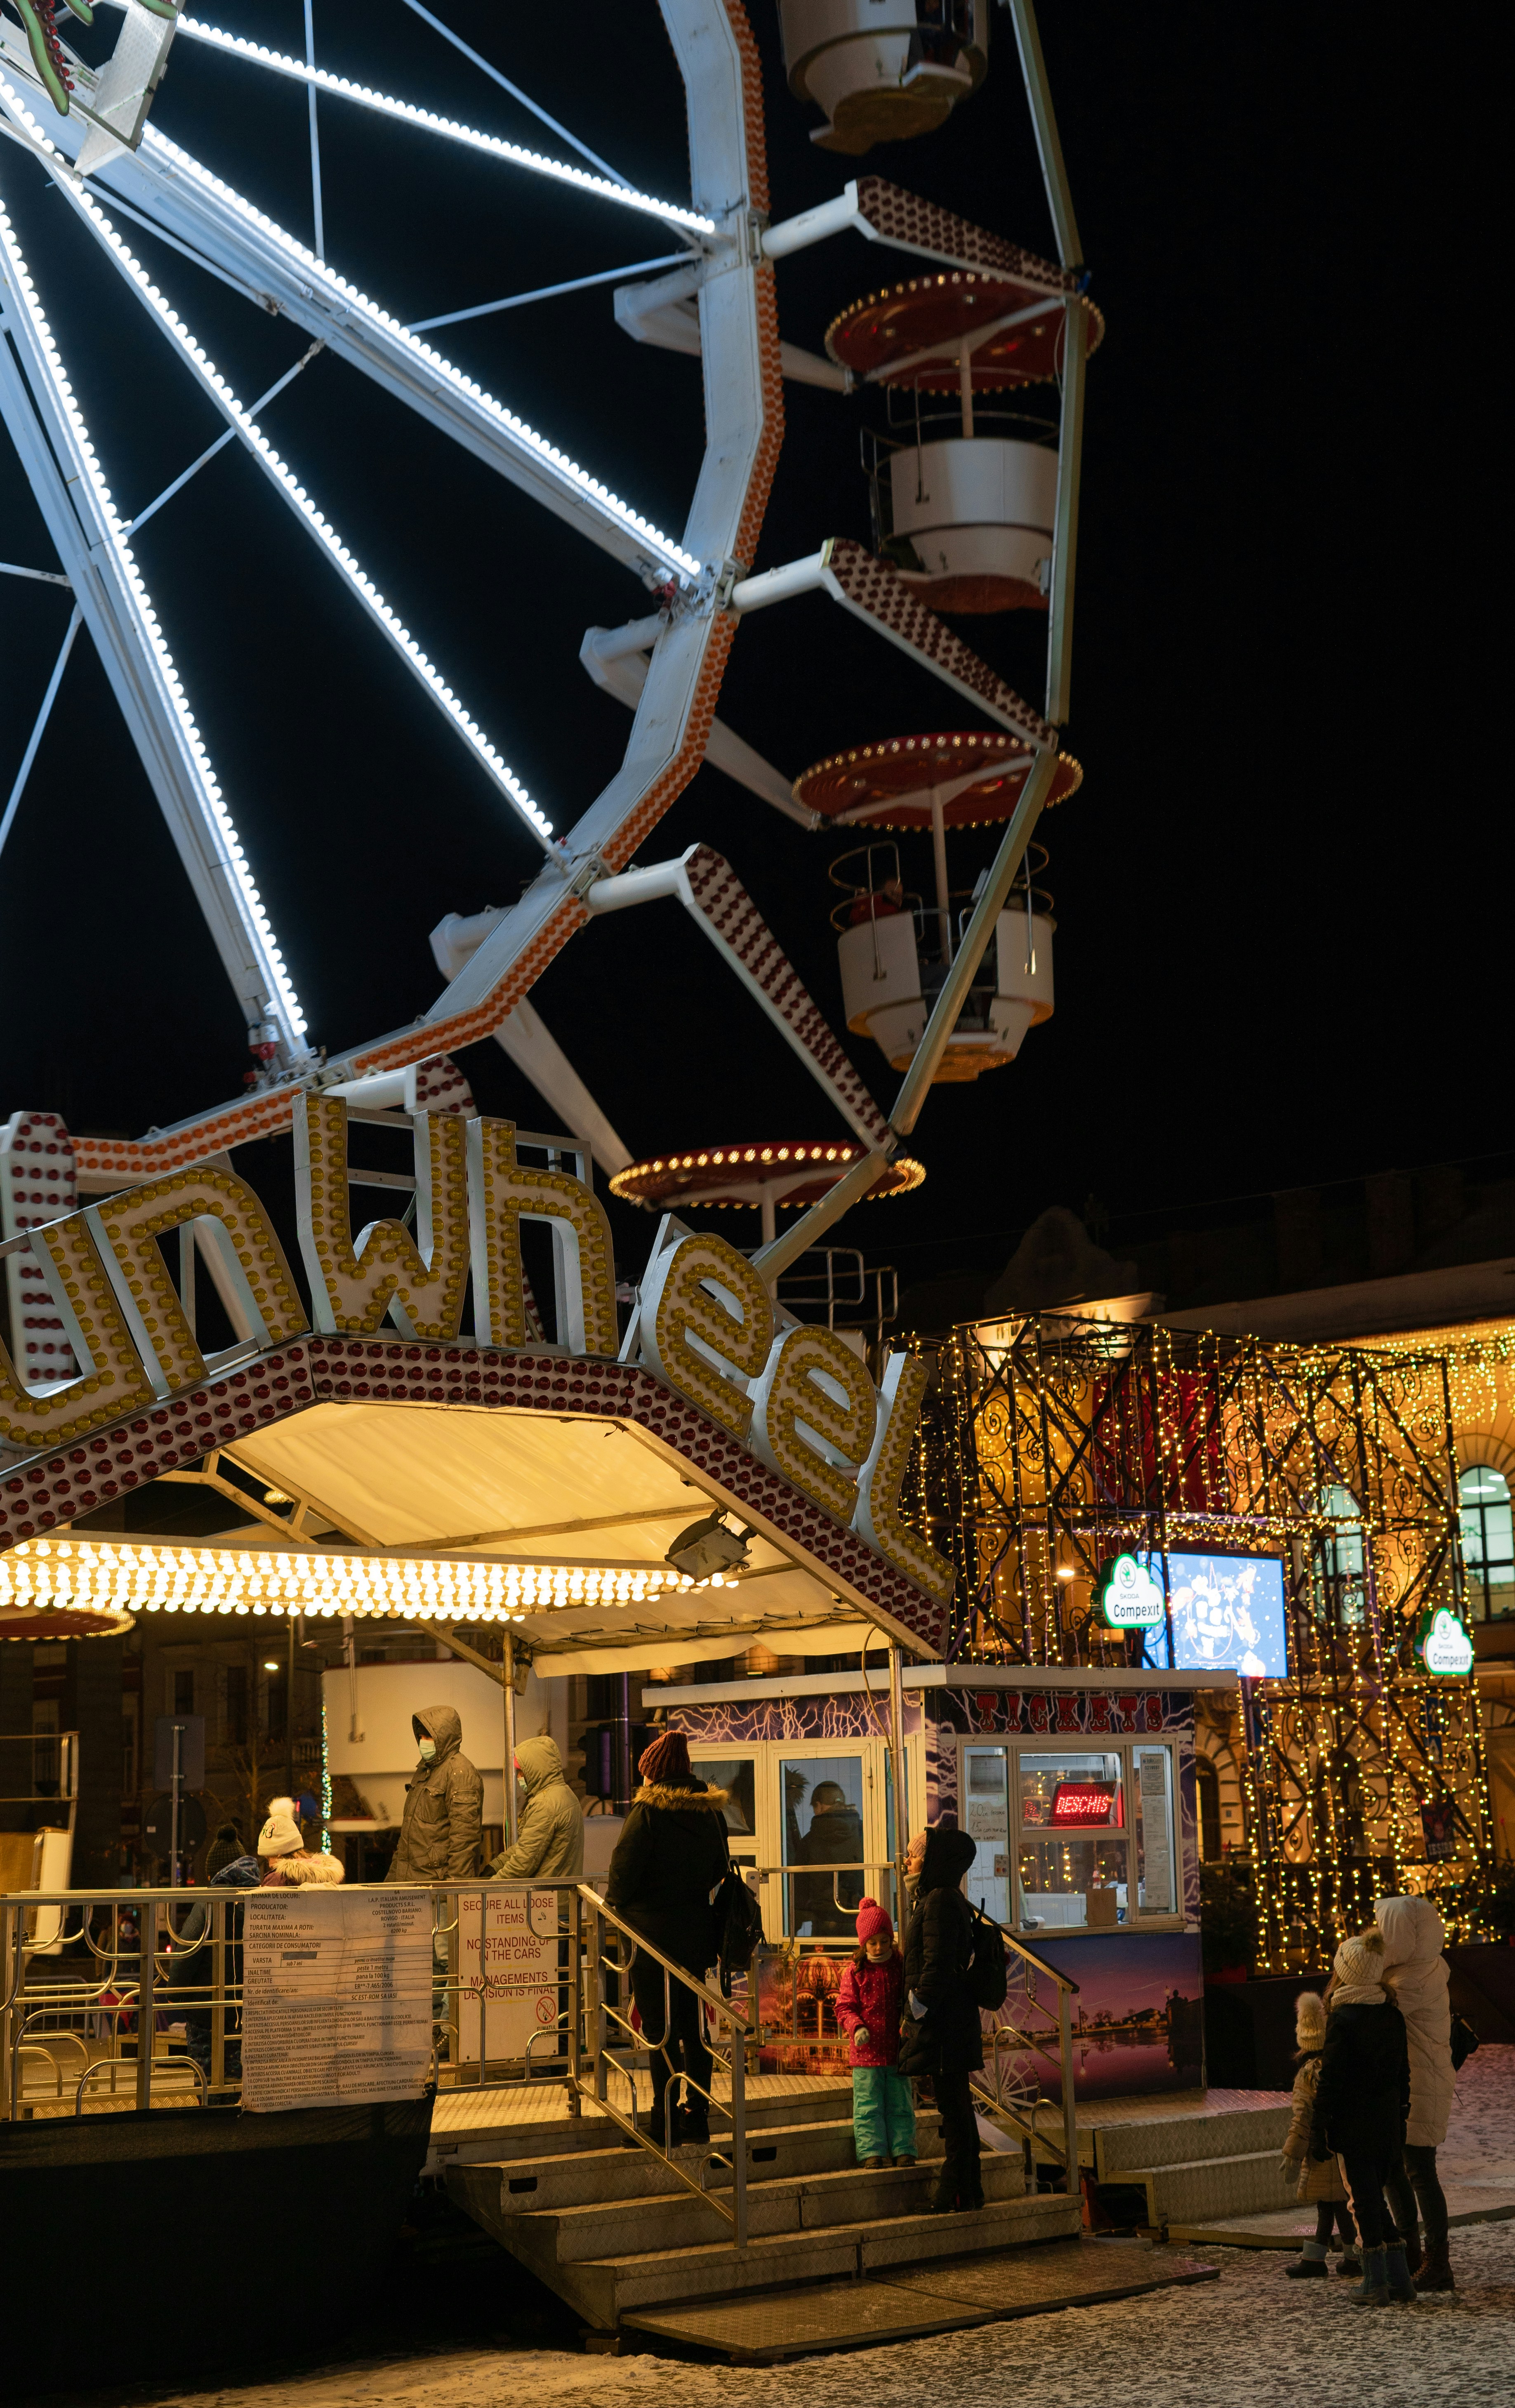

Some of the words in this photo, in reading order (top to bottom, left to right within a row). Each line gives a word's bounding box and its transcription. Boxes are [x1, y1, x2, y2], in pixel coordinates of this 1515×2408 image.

[1114, 1604, 1159, 1619] Compexit
[975, 1692, 1163, 1733] TICKETS
[504, 1899, 520, 1909] ALL
[497, 1914, 524, 1924] ITEMS
[467, 1939, 481, 1949] NO
[485, 1936, 535, 1949] STANDING
[492, 1949, 511, 1961] THE
[514, 1948, 540, 1959] CARS
[471, 1972, 547, 1987] MANAGEMENTS
[464, 1989, 512, 2000] DEISION
